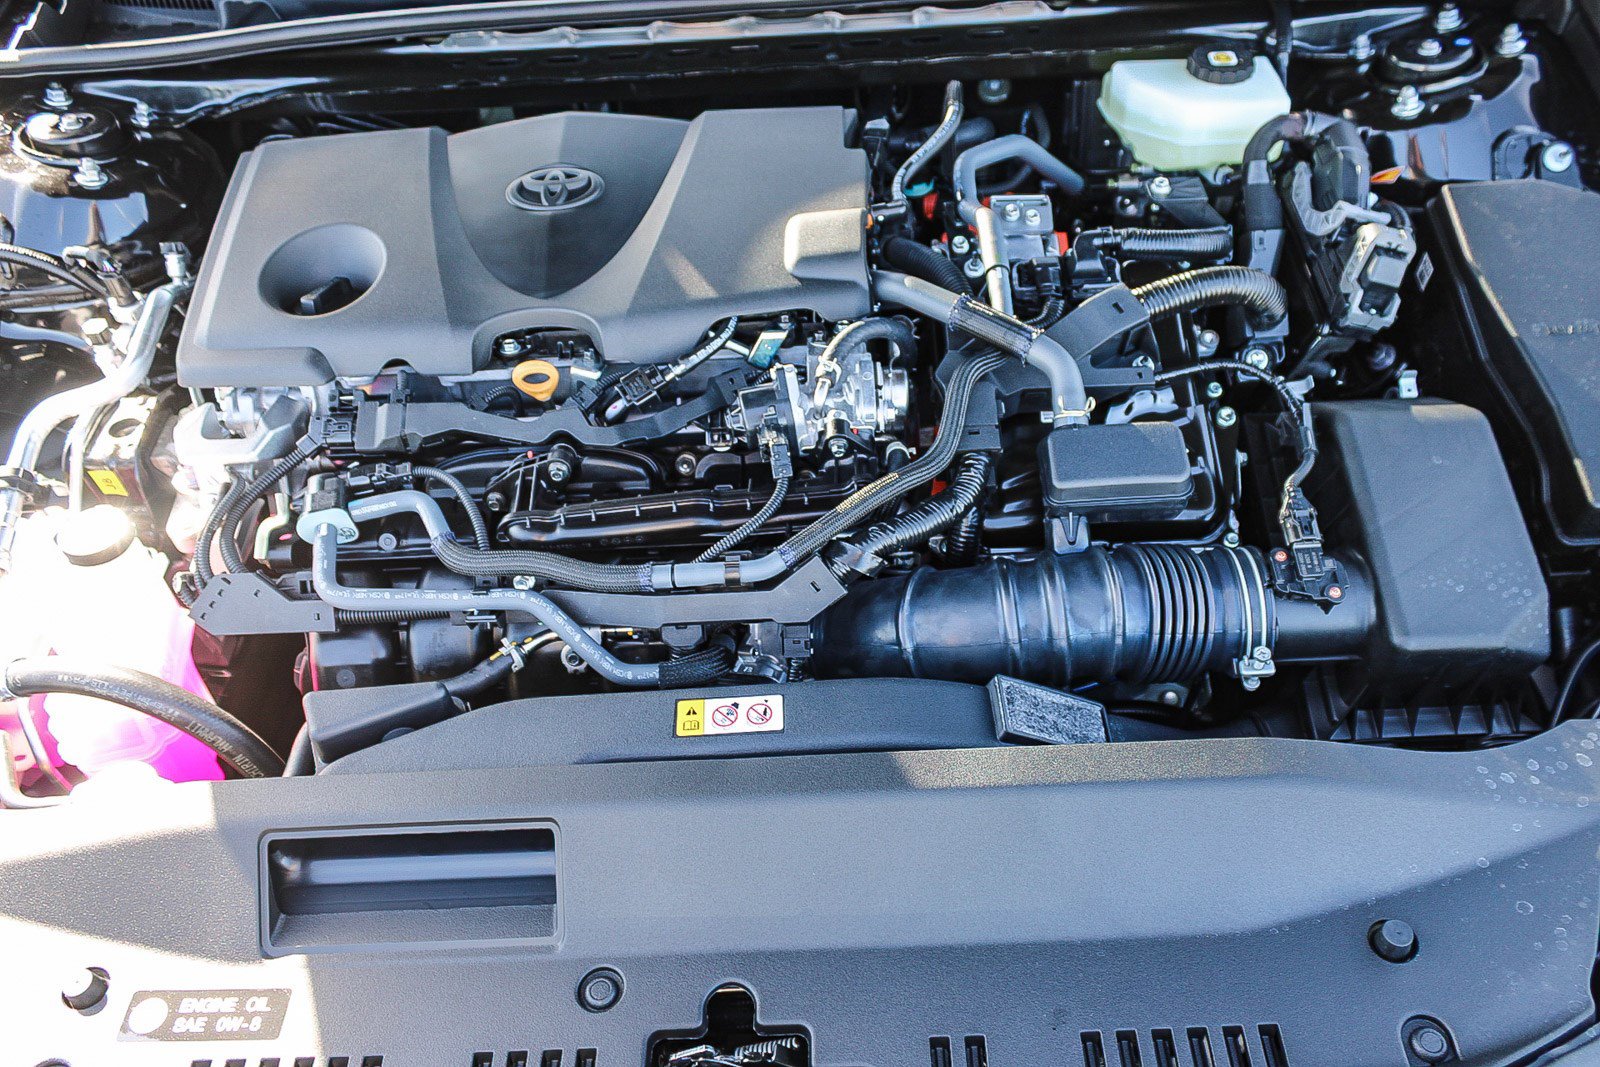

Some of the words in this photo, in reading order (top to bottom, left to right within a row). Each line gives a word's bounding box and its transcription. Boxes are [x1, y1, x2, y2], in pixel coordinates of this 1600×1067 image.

[178, 997, 239, 1013] ENGINE
[245, 996, 271, 1012] OIL
[172, 1016, 208, 1033] SAE
